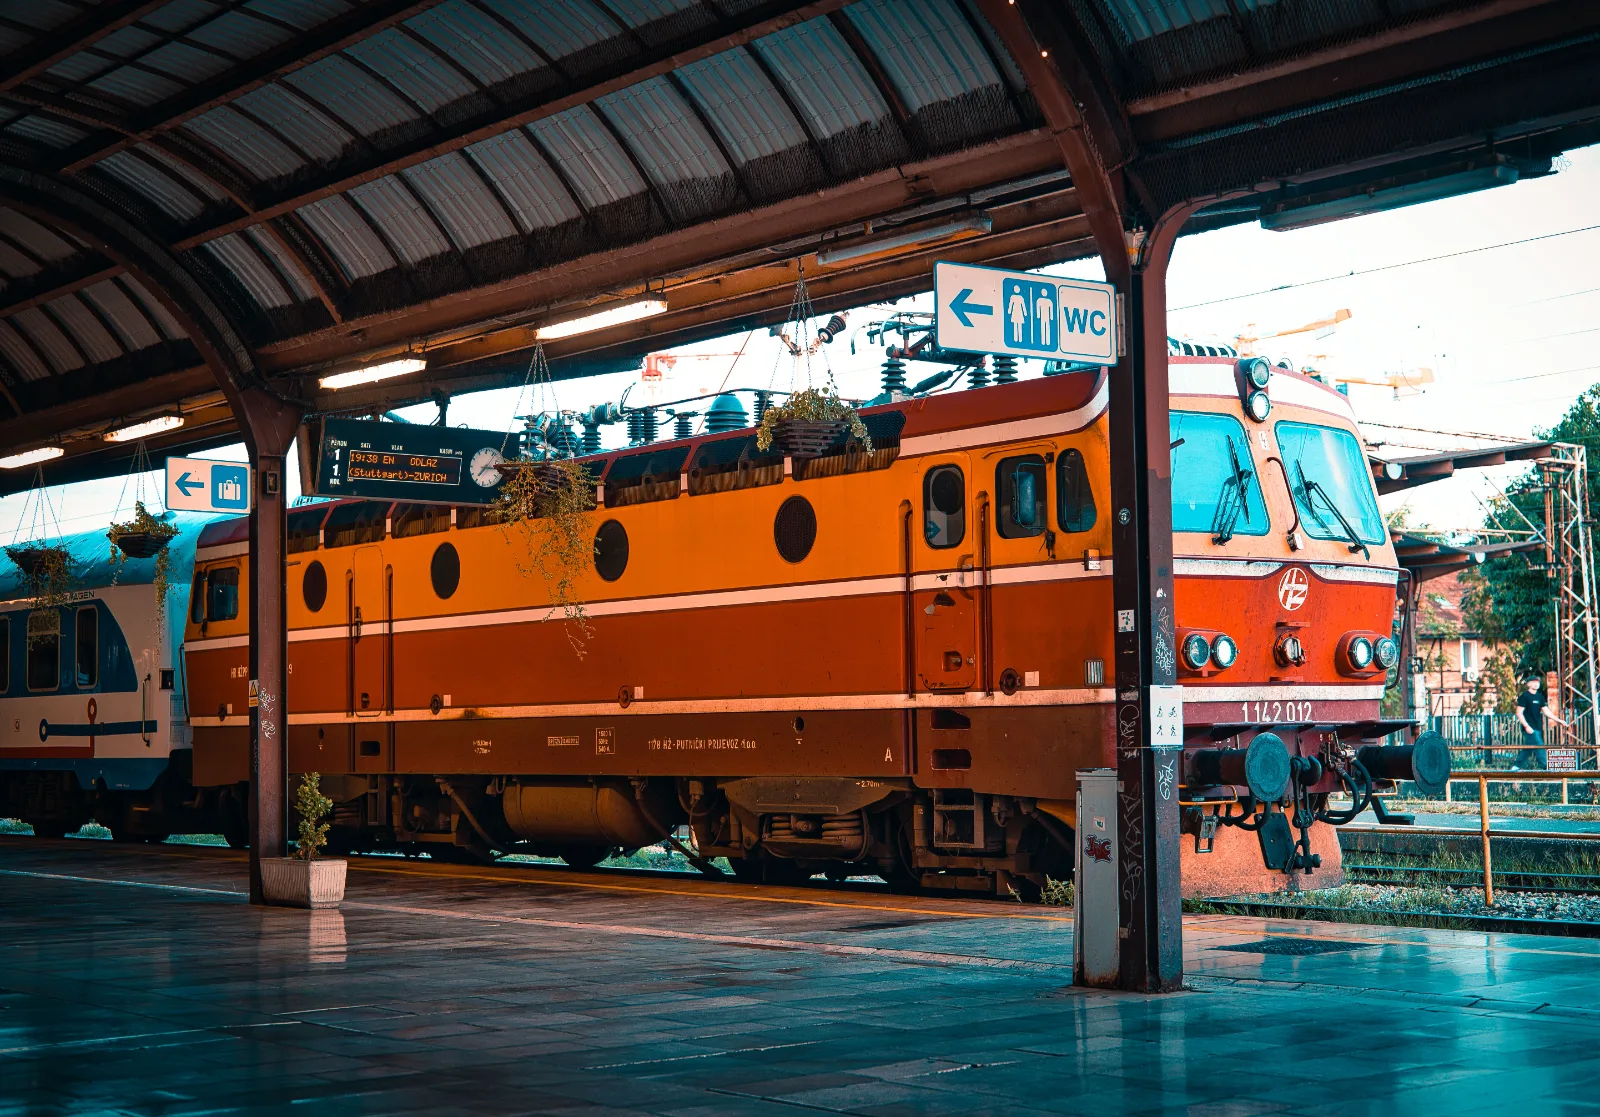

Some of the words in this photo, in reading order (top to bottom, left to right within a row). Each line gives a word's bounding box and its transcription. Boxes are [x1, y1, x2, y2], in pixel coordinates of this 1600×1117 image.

[1063, 306, 1106, 336] WC
[334, 449, 340, 461] 1
[350, 452, 379, 464] 19:38
[382, 455, 395, 465] EN
[410, 457, 438, 468] ODLAZ
[1241, 701, 1248, 722] 1
[1254, 701, 1282, 722] 142
[1286, 701, 1312, 722] 012
[707, 738, 739, 749] PRIJEVOZ
[884, 747, 893, 762] A
